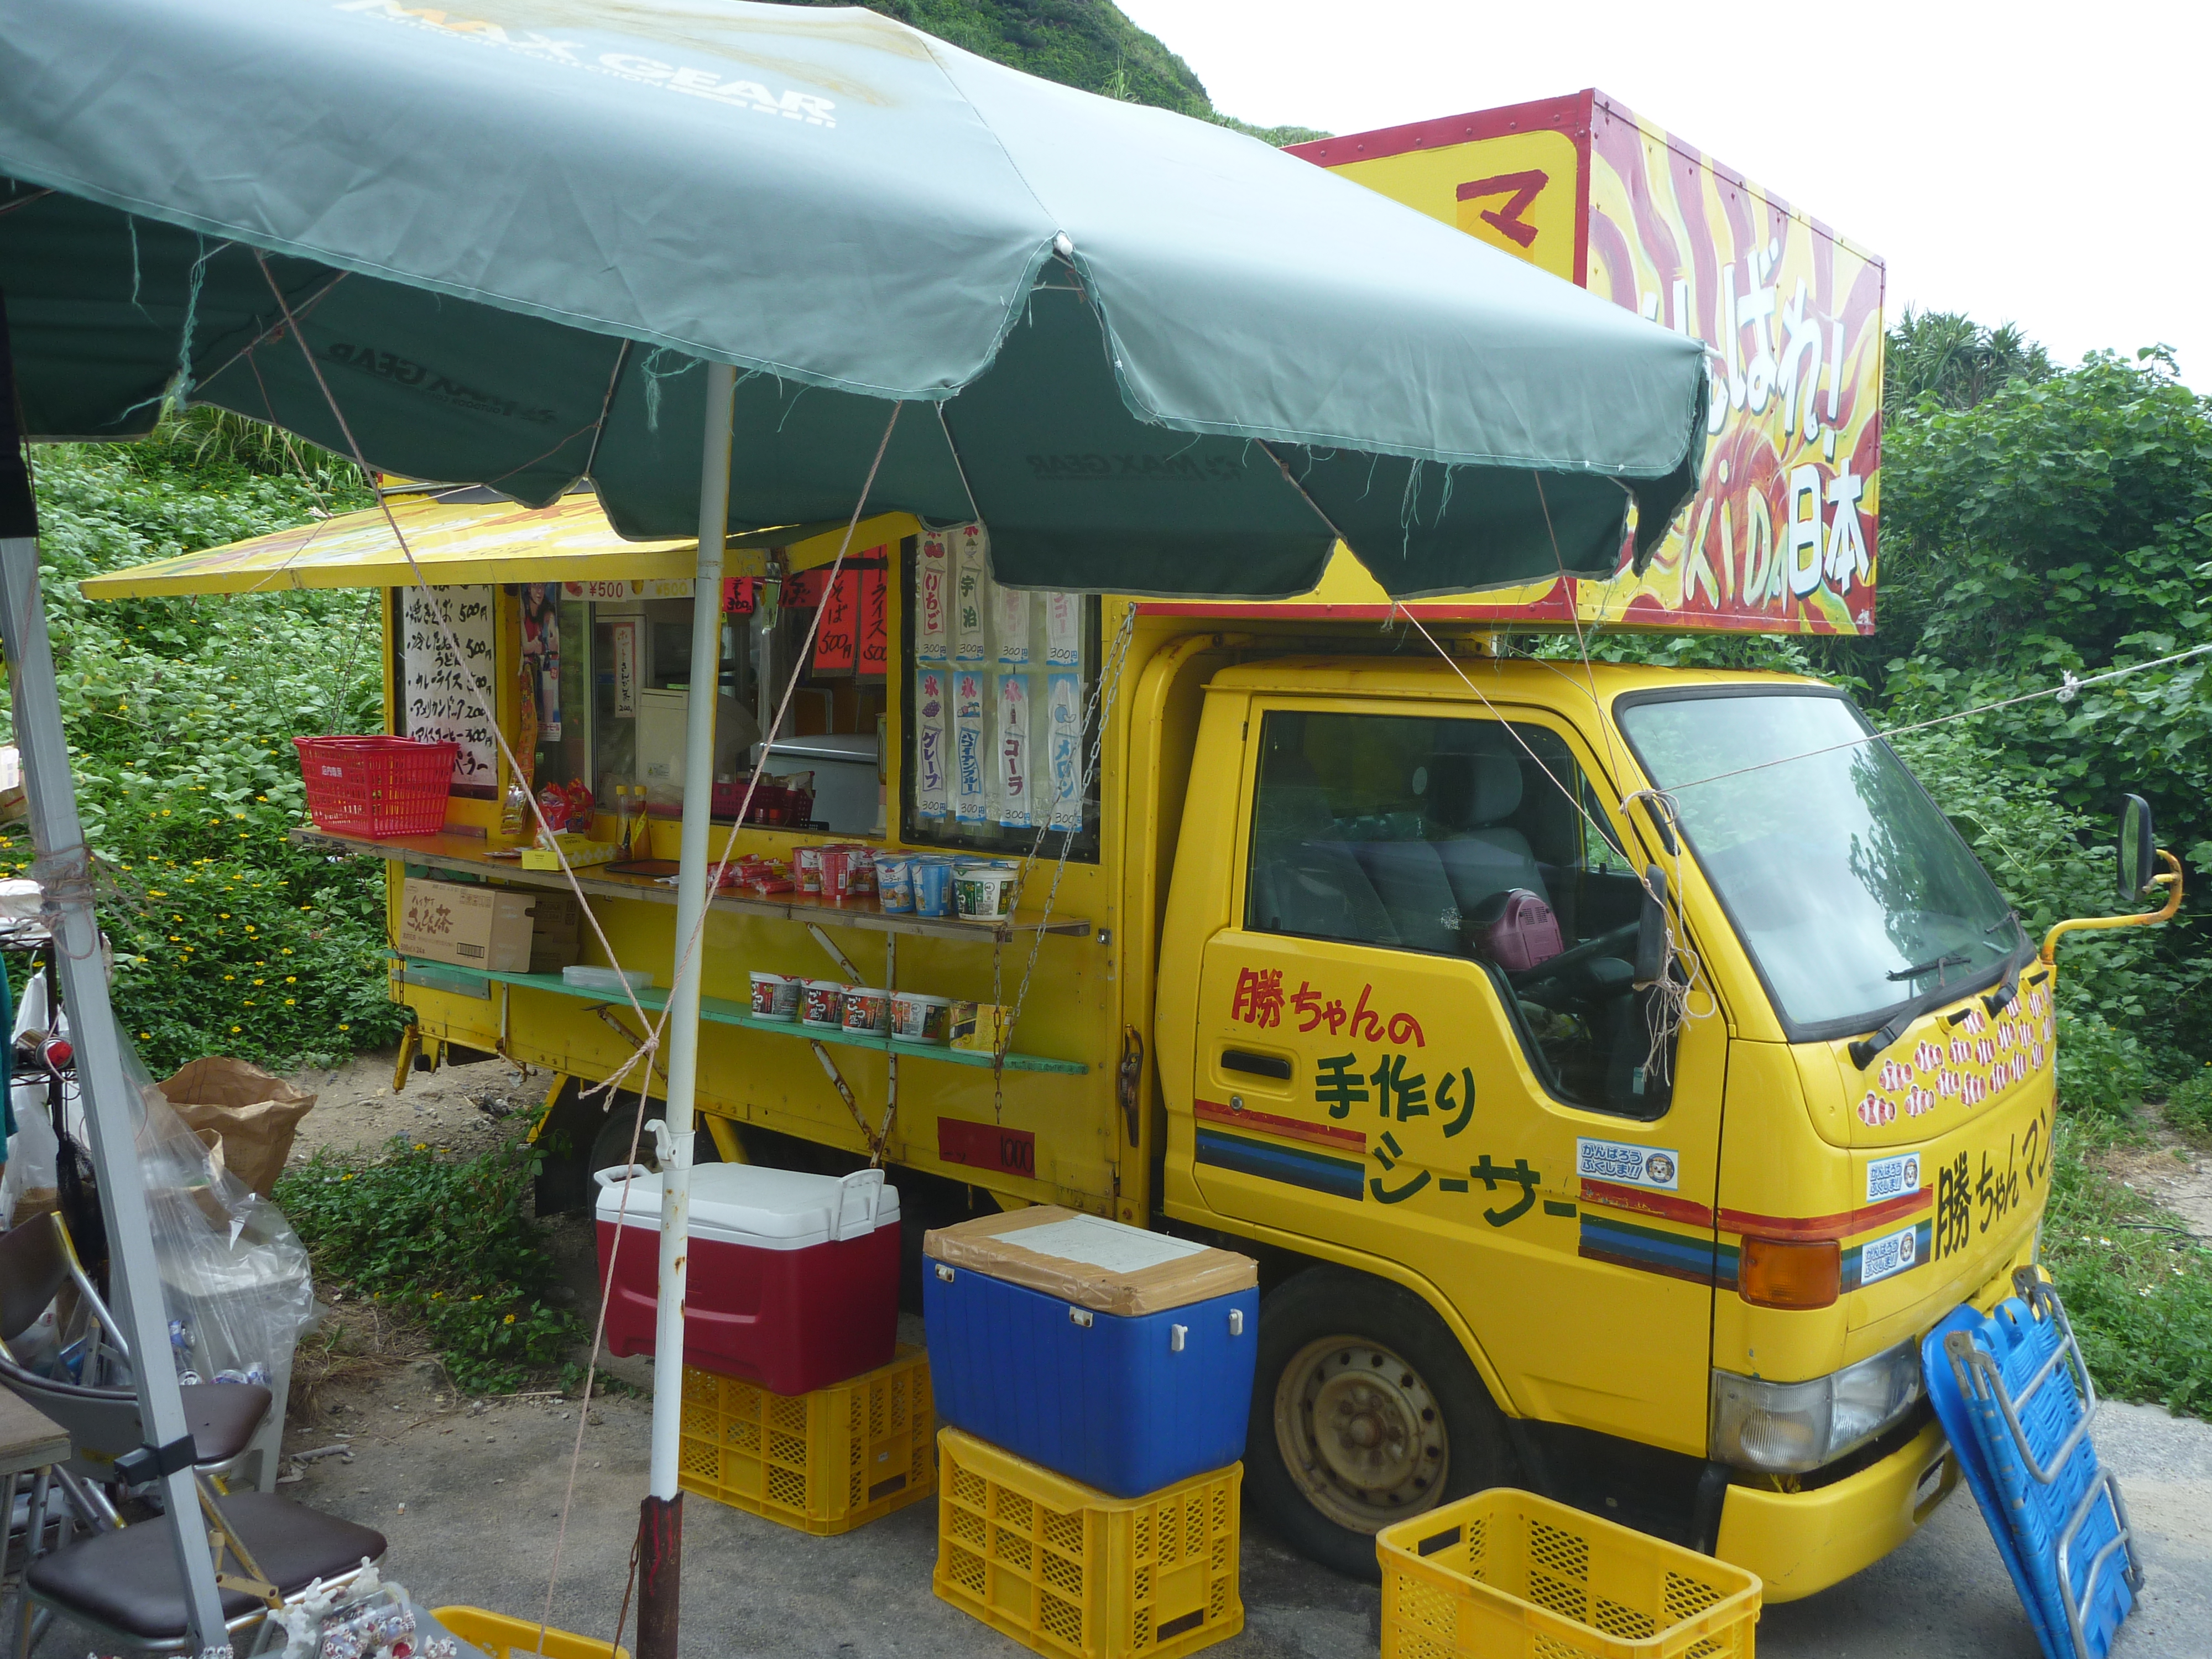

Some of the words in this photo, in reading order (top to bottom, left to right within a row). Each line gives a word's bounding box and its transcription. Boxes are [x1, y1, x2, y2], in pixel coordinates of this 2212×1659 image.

[599, 54, 837, 122] GEAR
[1456, 169, 1549, 249] マ
[1788, 458, 1870, 601] 日本
[589, 582, 623, 598] ¥500
[925, 573, 941, 630] いちご
[960, 575, 977, 628] 宇治
[459, 602, 488, 623] 500円
[465, 638, 492, 661] 500円
[818, 630, 852, 659] 500円
[923, 643, 946, 654] 300円
[959, 643, 984, 654] 300円
[1003, 645, 1028, 656] 300円
[1050, 648, 1078, 659] 300円
[415, 670, 463, 691] カレーライス
[924, 675, 939, 697] 氷
[961, 675, 977, 699] 氷
[1004, 679, 1022, 703] 氷
[465, 706, 489, 722] 200
[922, 731, 940, 788] グレープ
[961, 732, 978, 791] ハワイアンブルー
[1004, 739, 1023, 796] コーラ
[1055, 739, 1074, 799] メロン
[922, 801, 946, 811] 300円
[961, 804, 985, 814] 300円
[1005, 809, 1030, 821] 300円
[1231, 966, 1426, 1047] 勝ちゃんの
[1314, 1051, 1475, 1138] 手作り
[1000, 1134, 1034, 1173] 1000
[1582, 1143, 1642, 1164] がんばろう
[1370, 1130, 1578, 1227] シーサー
[1870, 1161, 1902, 1182] がんばろう
[1865, 1238, 1899, 1264] がんばろう
